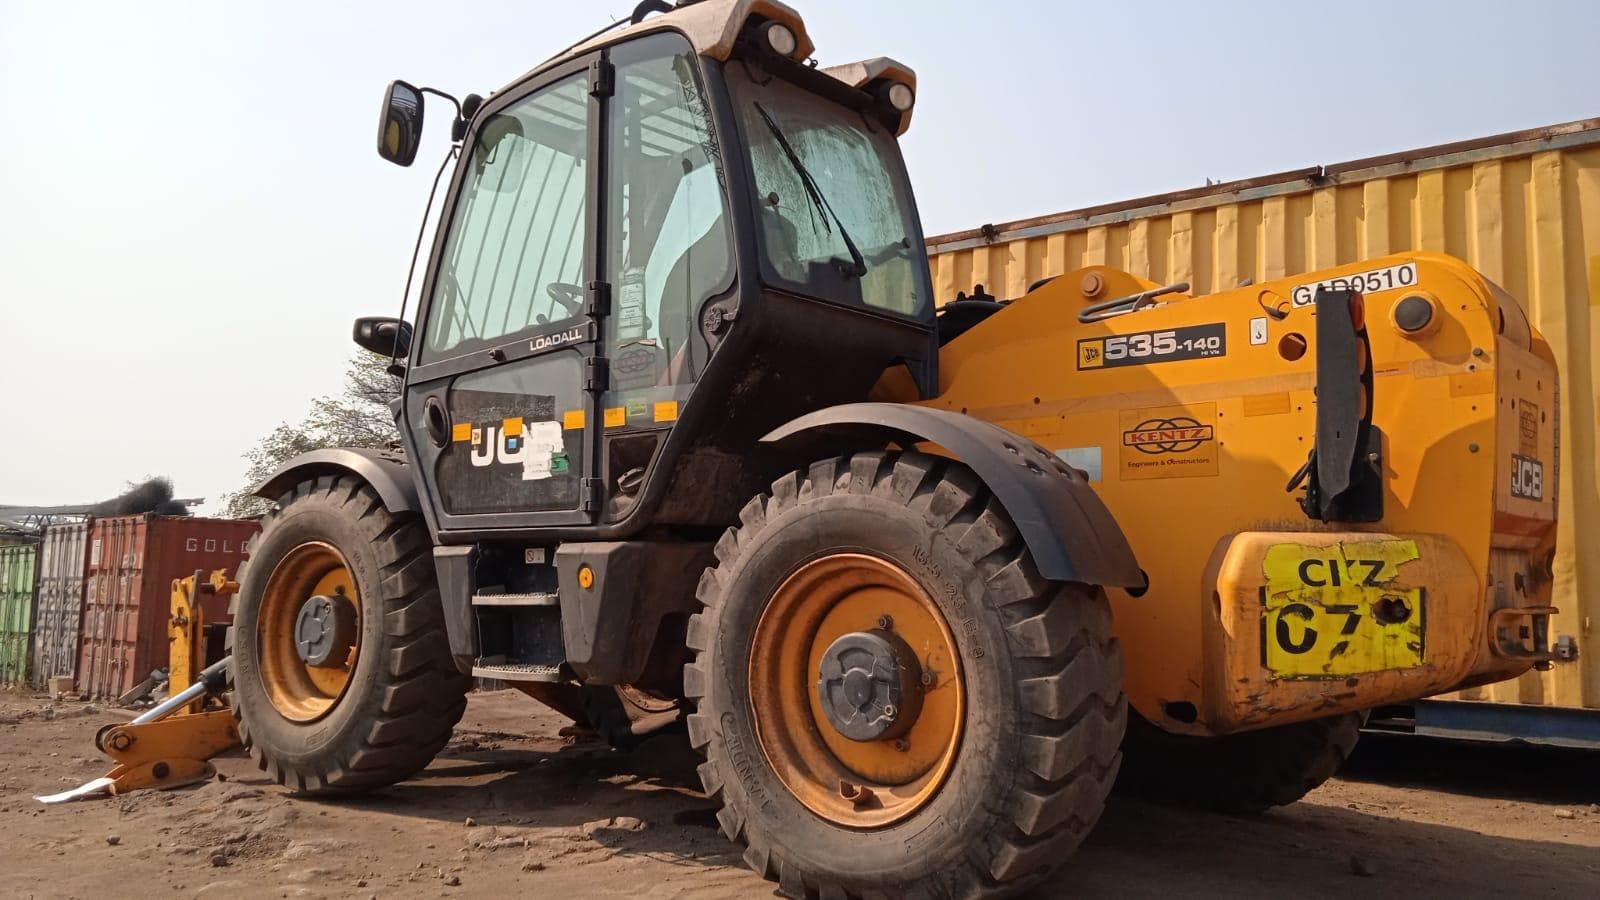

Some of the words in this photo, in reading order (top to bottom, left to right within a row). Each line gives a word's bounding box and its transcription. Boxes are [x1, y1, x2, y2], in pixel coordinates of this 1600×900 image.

[530, 329, 582, 351] LOADALL
[1131, 428, 1205, 444] KENTZ
[1512, 457, 1542, 499] JCB
